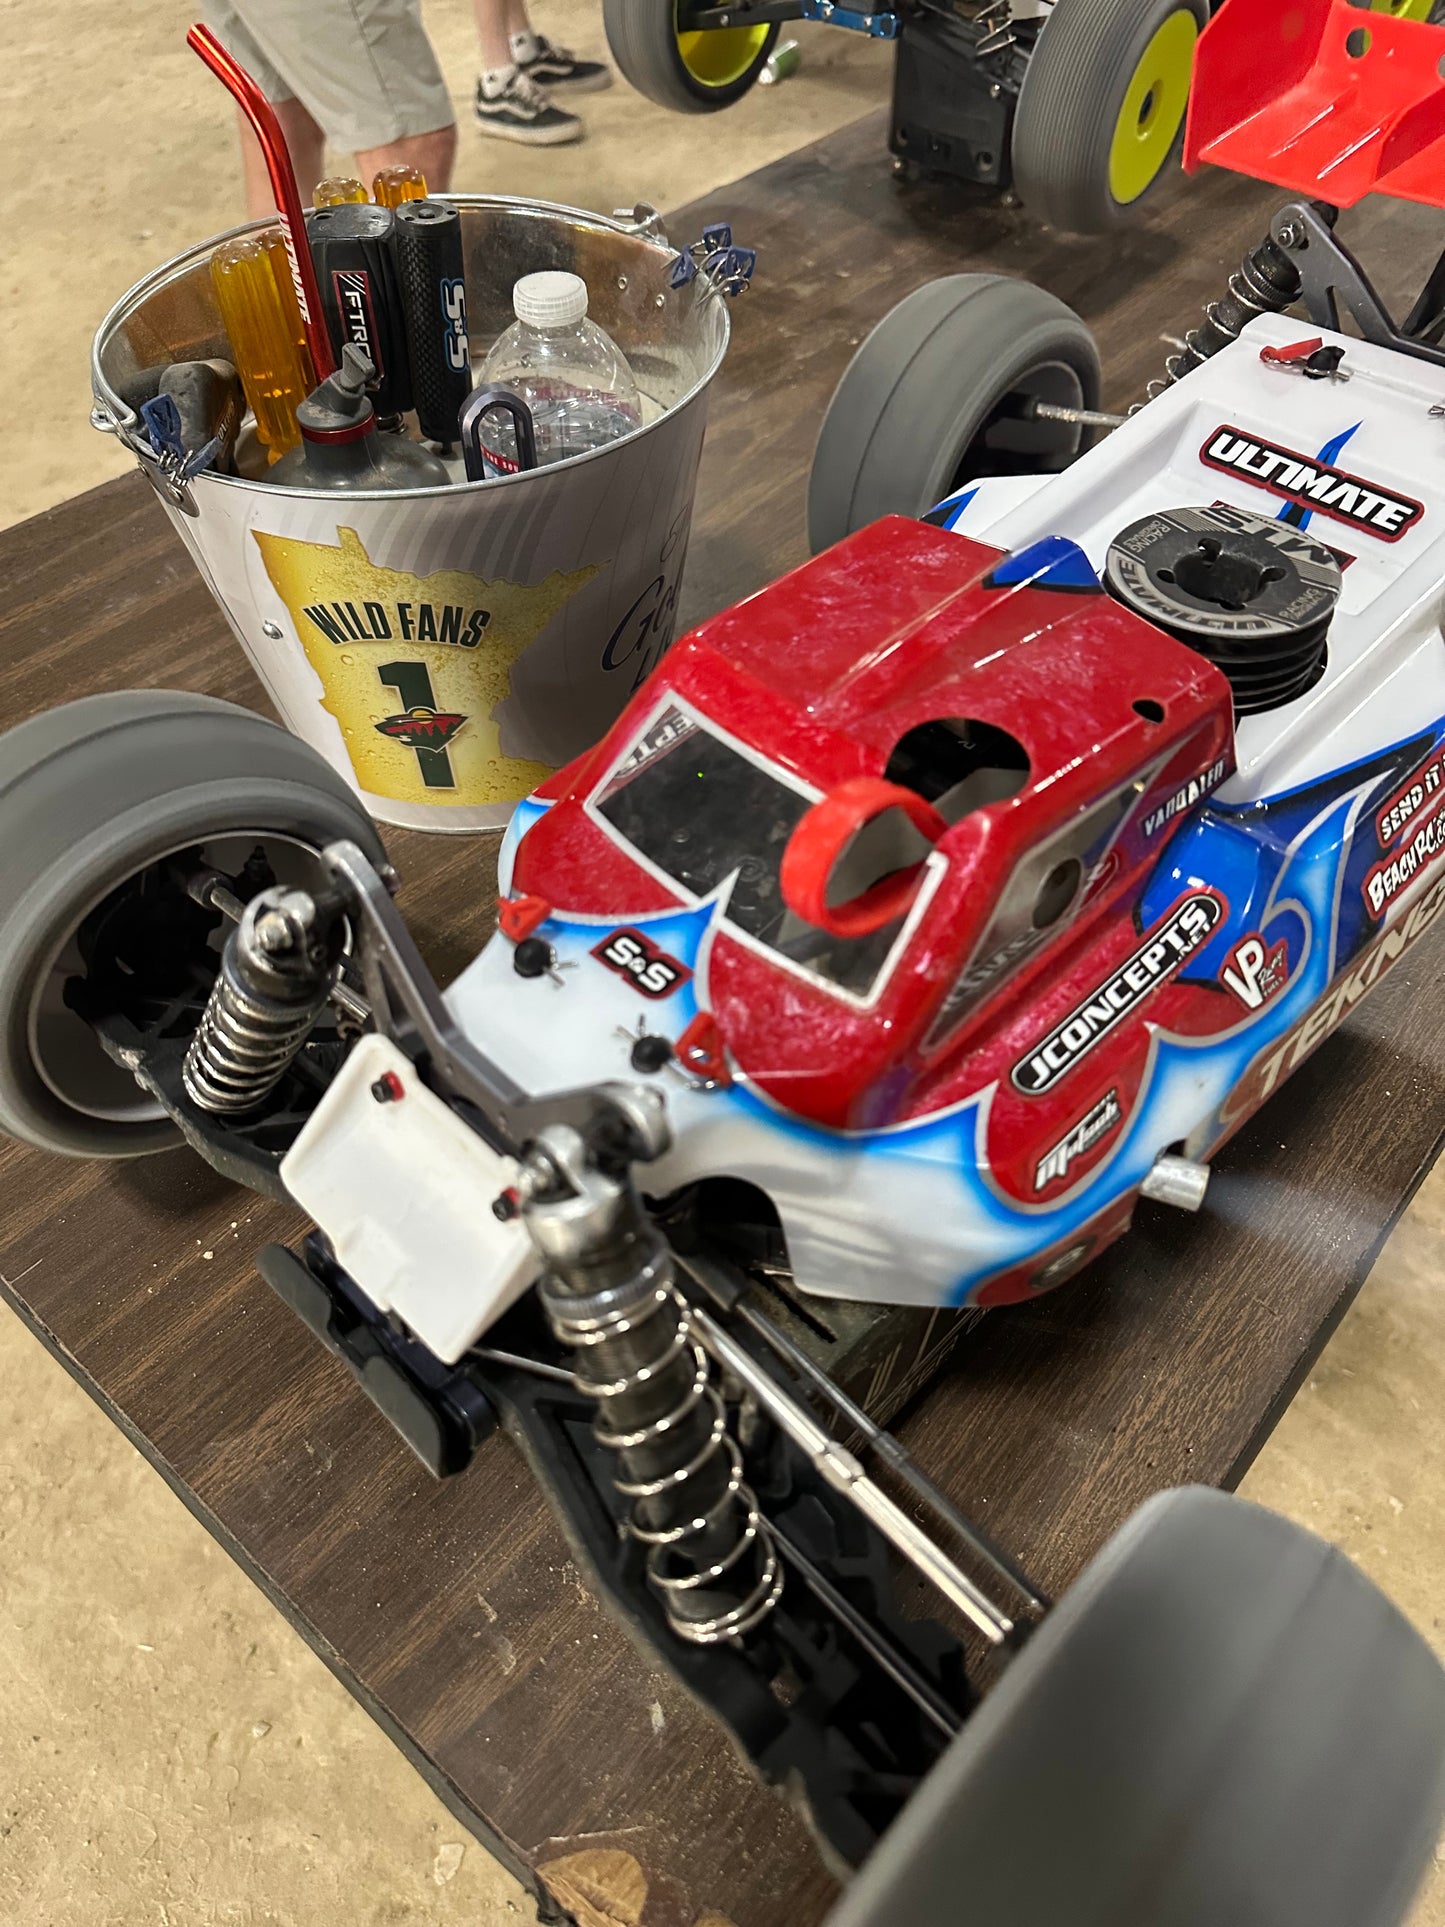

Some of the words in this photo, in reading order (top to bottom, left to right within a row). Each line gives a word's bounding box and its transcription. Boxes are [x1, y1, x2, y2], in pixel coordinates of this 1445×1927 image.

[279, 210, 312, 325] ULTIMATE
[443, 284, 470, 369] S&S
[1207, 432, 1414, 532] ULTIMATE
[1130, 523, 1171, 553] RACING
[302, 601, 392, 645] WILD
[396, 602, 491, 648] FANS
[377, 661, 456, 788] 1
[1381, 783, 1424, 843] SEND
[604, 935, 677, 993] S&S
[1027, 902, 1207, 1089] JCONCEPTS
[1223, 939, 1264, 1009] VP
